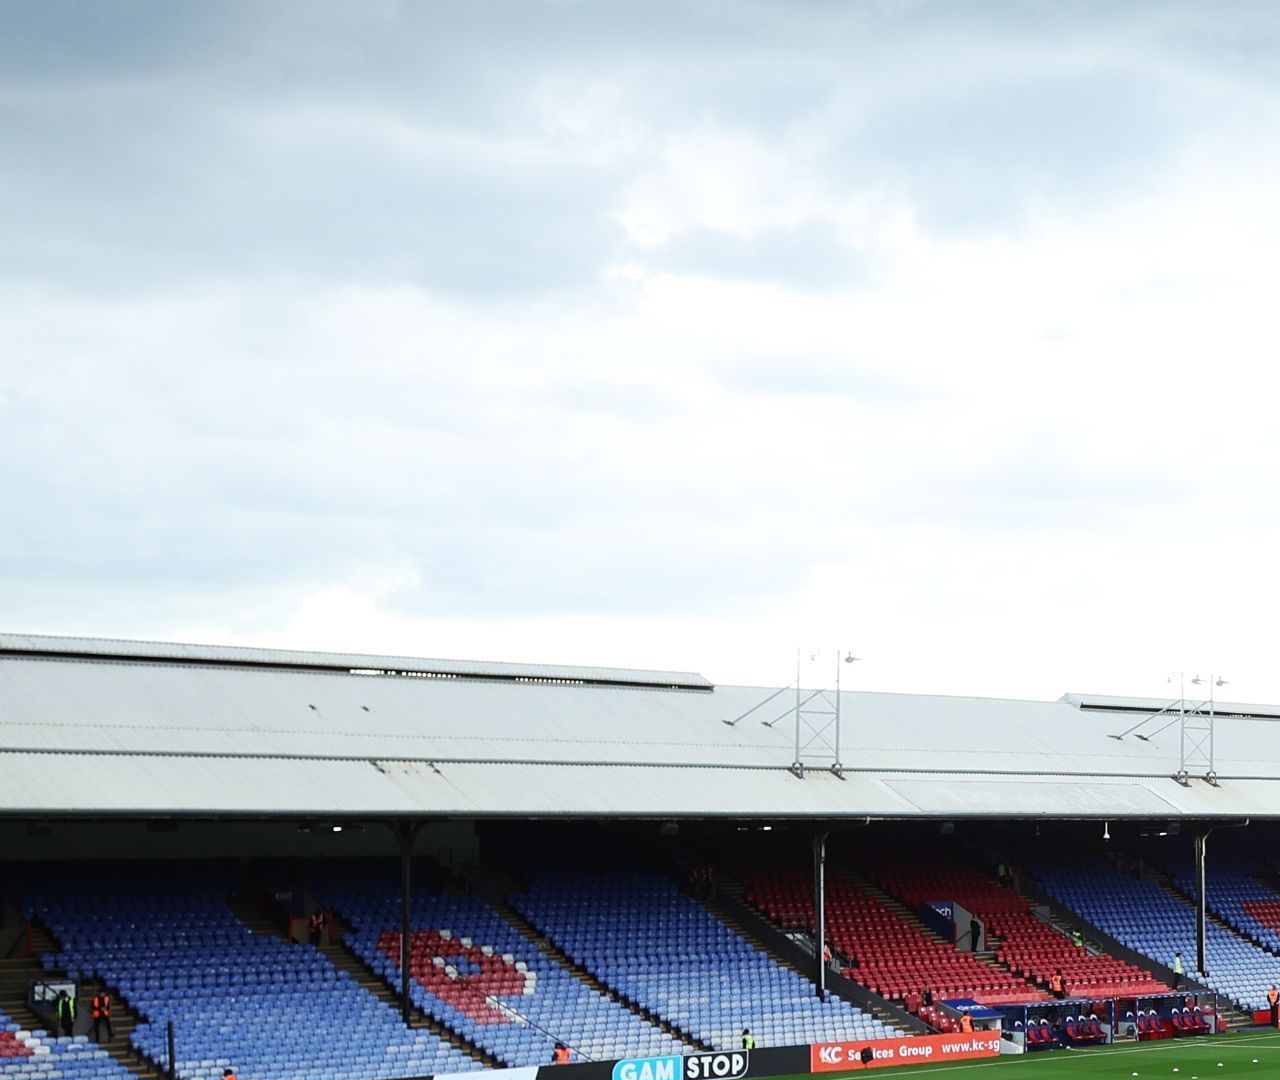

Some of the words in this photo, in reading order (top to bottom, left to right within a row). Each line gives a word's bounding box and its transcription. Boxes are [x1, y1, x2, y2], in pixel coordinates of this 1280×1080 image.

[820, 1046, 843, 1063] KC
[848, 1046, 894, 1062] Seices
[899, 1044, 933, 1058] Group
[941, 1038, 1000, 1055] www.kc-sg
[687, 1054, 745, 1079] STOP
